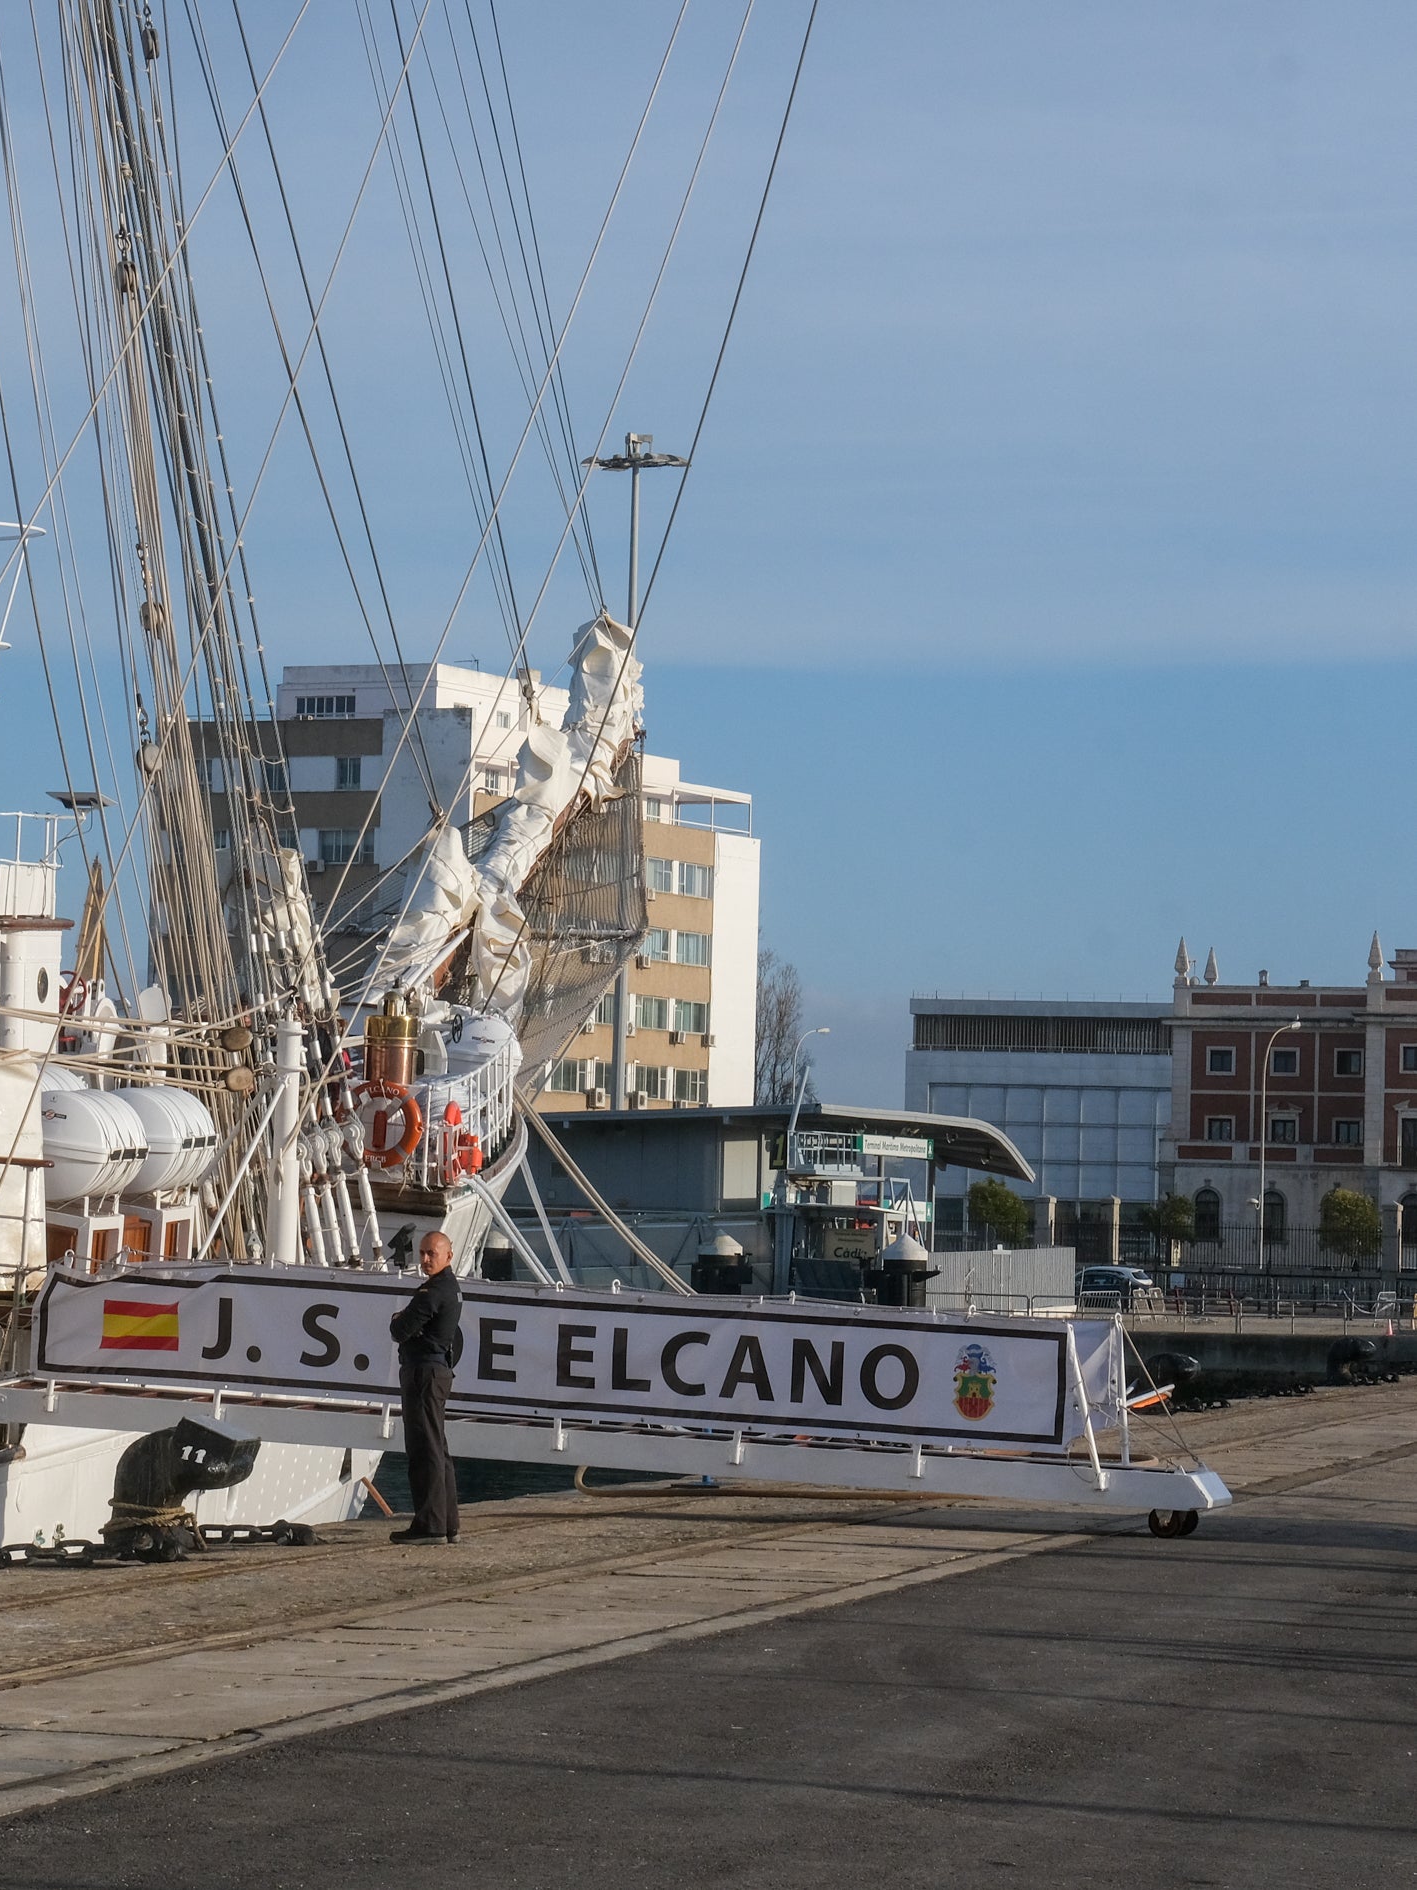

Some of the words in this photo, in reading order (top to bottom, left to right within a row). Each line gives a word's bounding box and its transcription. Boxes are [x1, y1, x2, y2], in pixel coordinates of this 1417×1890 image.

[773, 1134, 785, 1166] 1
[834, 1246, 867, 1258] Cádi
[202, 1298, 262, 1363] J.
[300, 1303, 370, 1372] S.
[453, 1316, 518, 1383] E
[555, 1323, 920, 1411] ELCANO
[181, 1446, 207, 1464] 11
